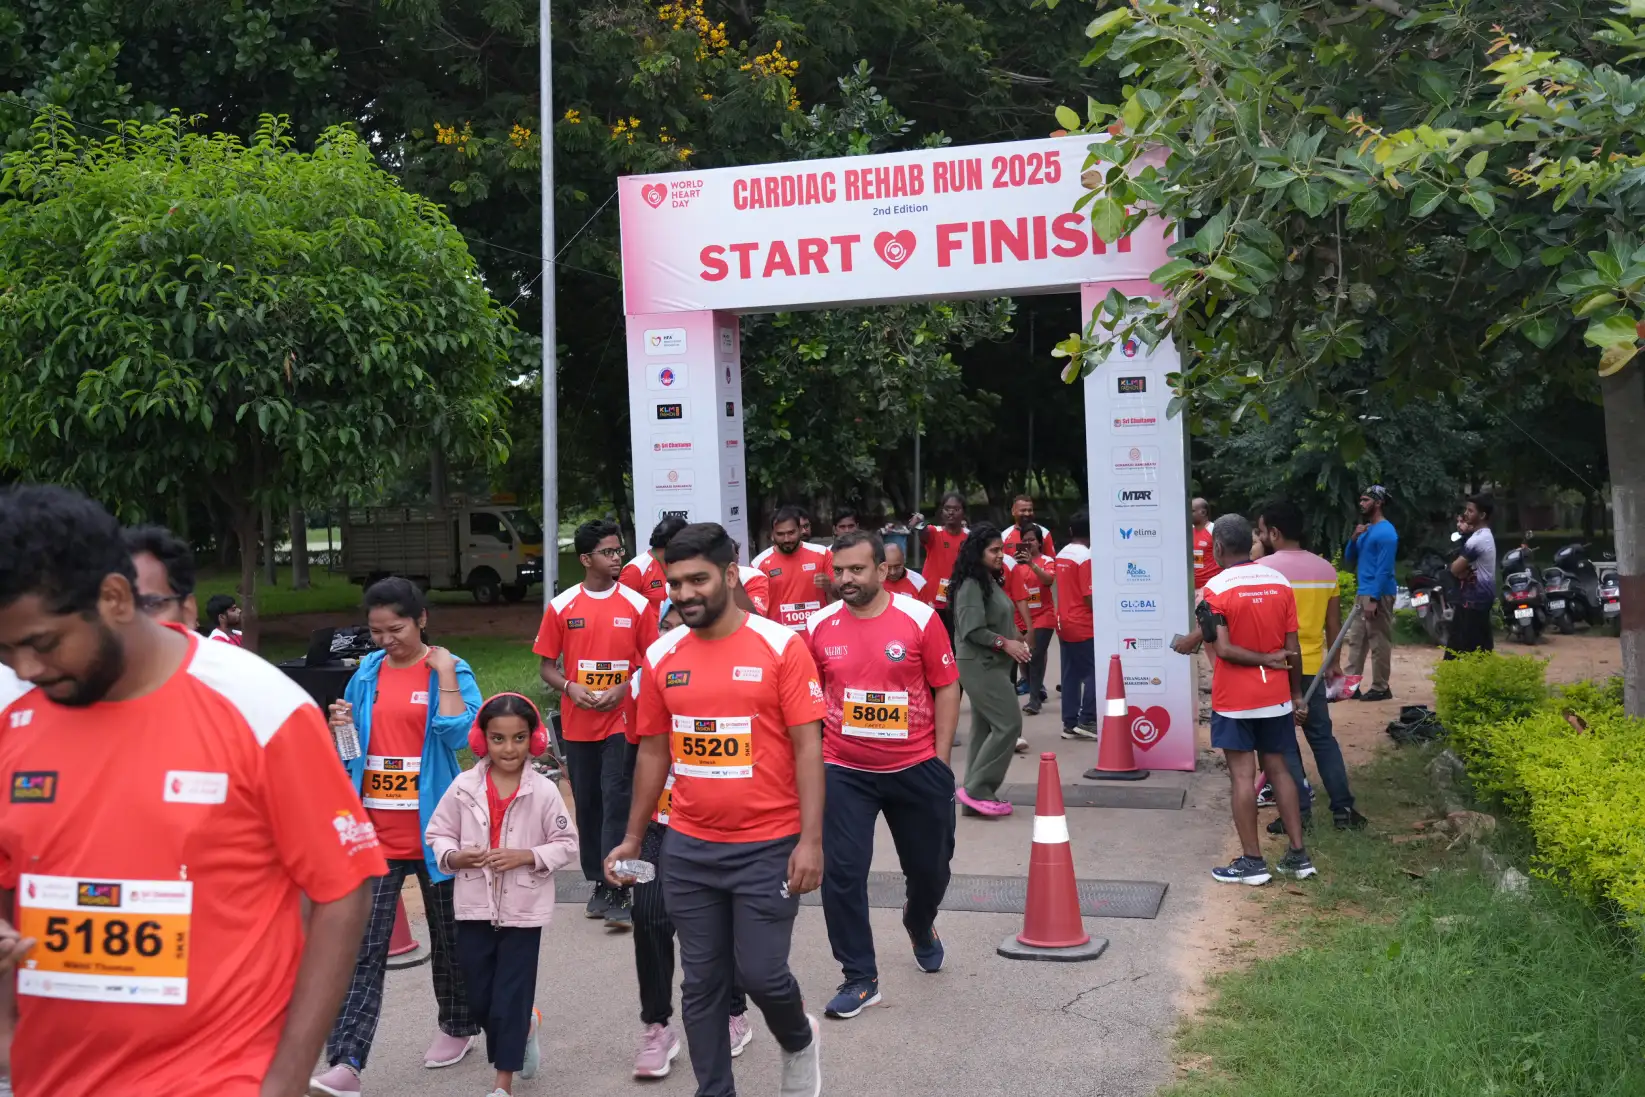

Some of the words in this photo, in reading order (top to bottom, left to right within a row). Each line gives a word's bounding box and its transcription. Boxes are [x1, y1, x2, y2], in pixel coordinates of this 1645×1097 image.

[671, 179, 704, 189] WORLD
[733, 171, 837, 211] CARDIAC
[844, 163, 925, 202] REHAB
[932, 158, 983, 194] RUN
[991, 150, 1062, 189] 2025
[671, 189, 701, 199] HEART
[672, 199, 690, 209] DAY
[872, 206, 892, 216] 2nd
[893, 203, 929, 214] Edition
[699, 234, 861, 282] START
[1121, 490, 1152, 501] MTAR
[1133, 528, 1157, 536] elima
[1126, 568, 1147, 576] Apollo
[1120, 600, 1157, 608] GLOBAL
[585, 673, 622, 685] 5778
[852, 705, 900, 722] 5804
[683, 736, 739, 757] 5520
[371, 774, 420, 791] 5521
[44, 915, 164, 957] 5186
